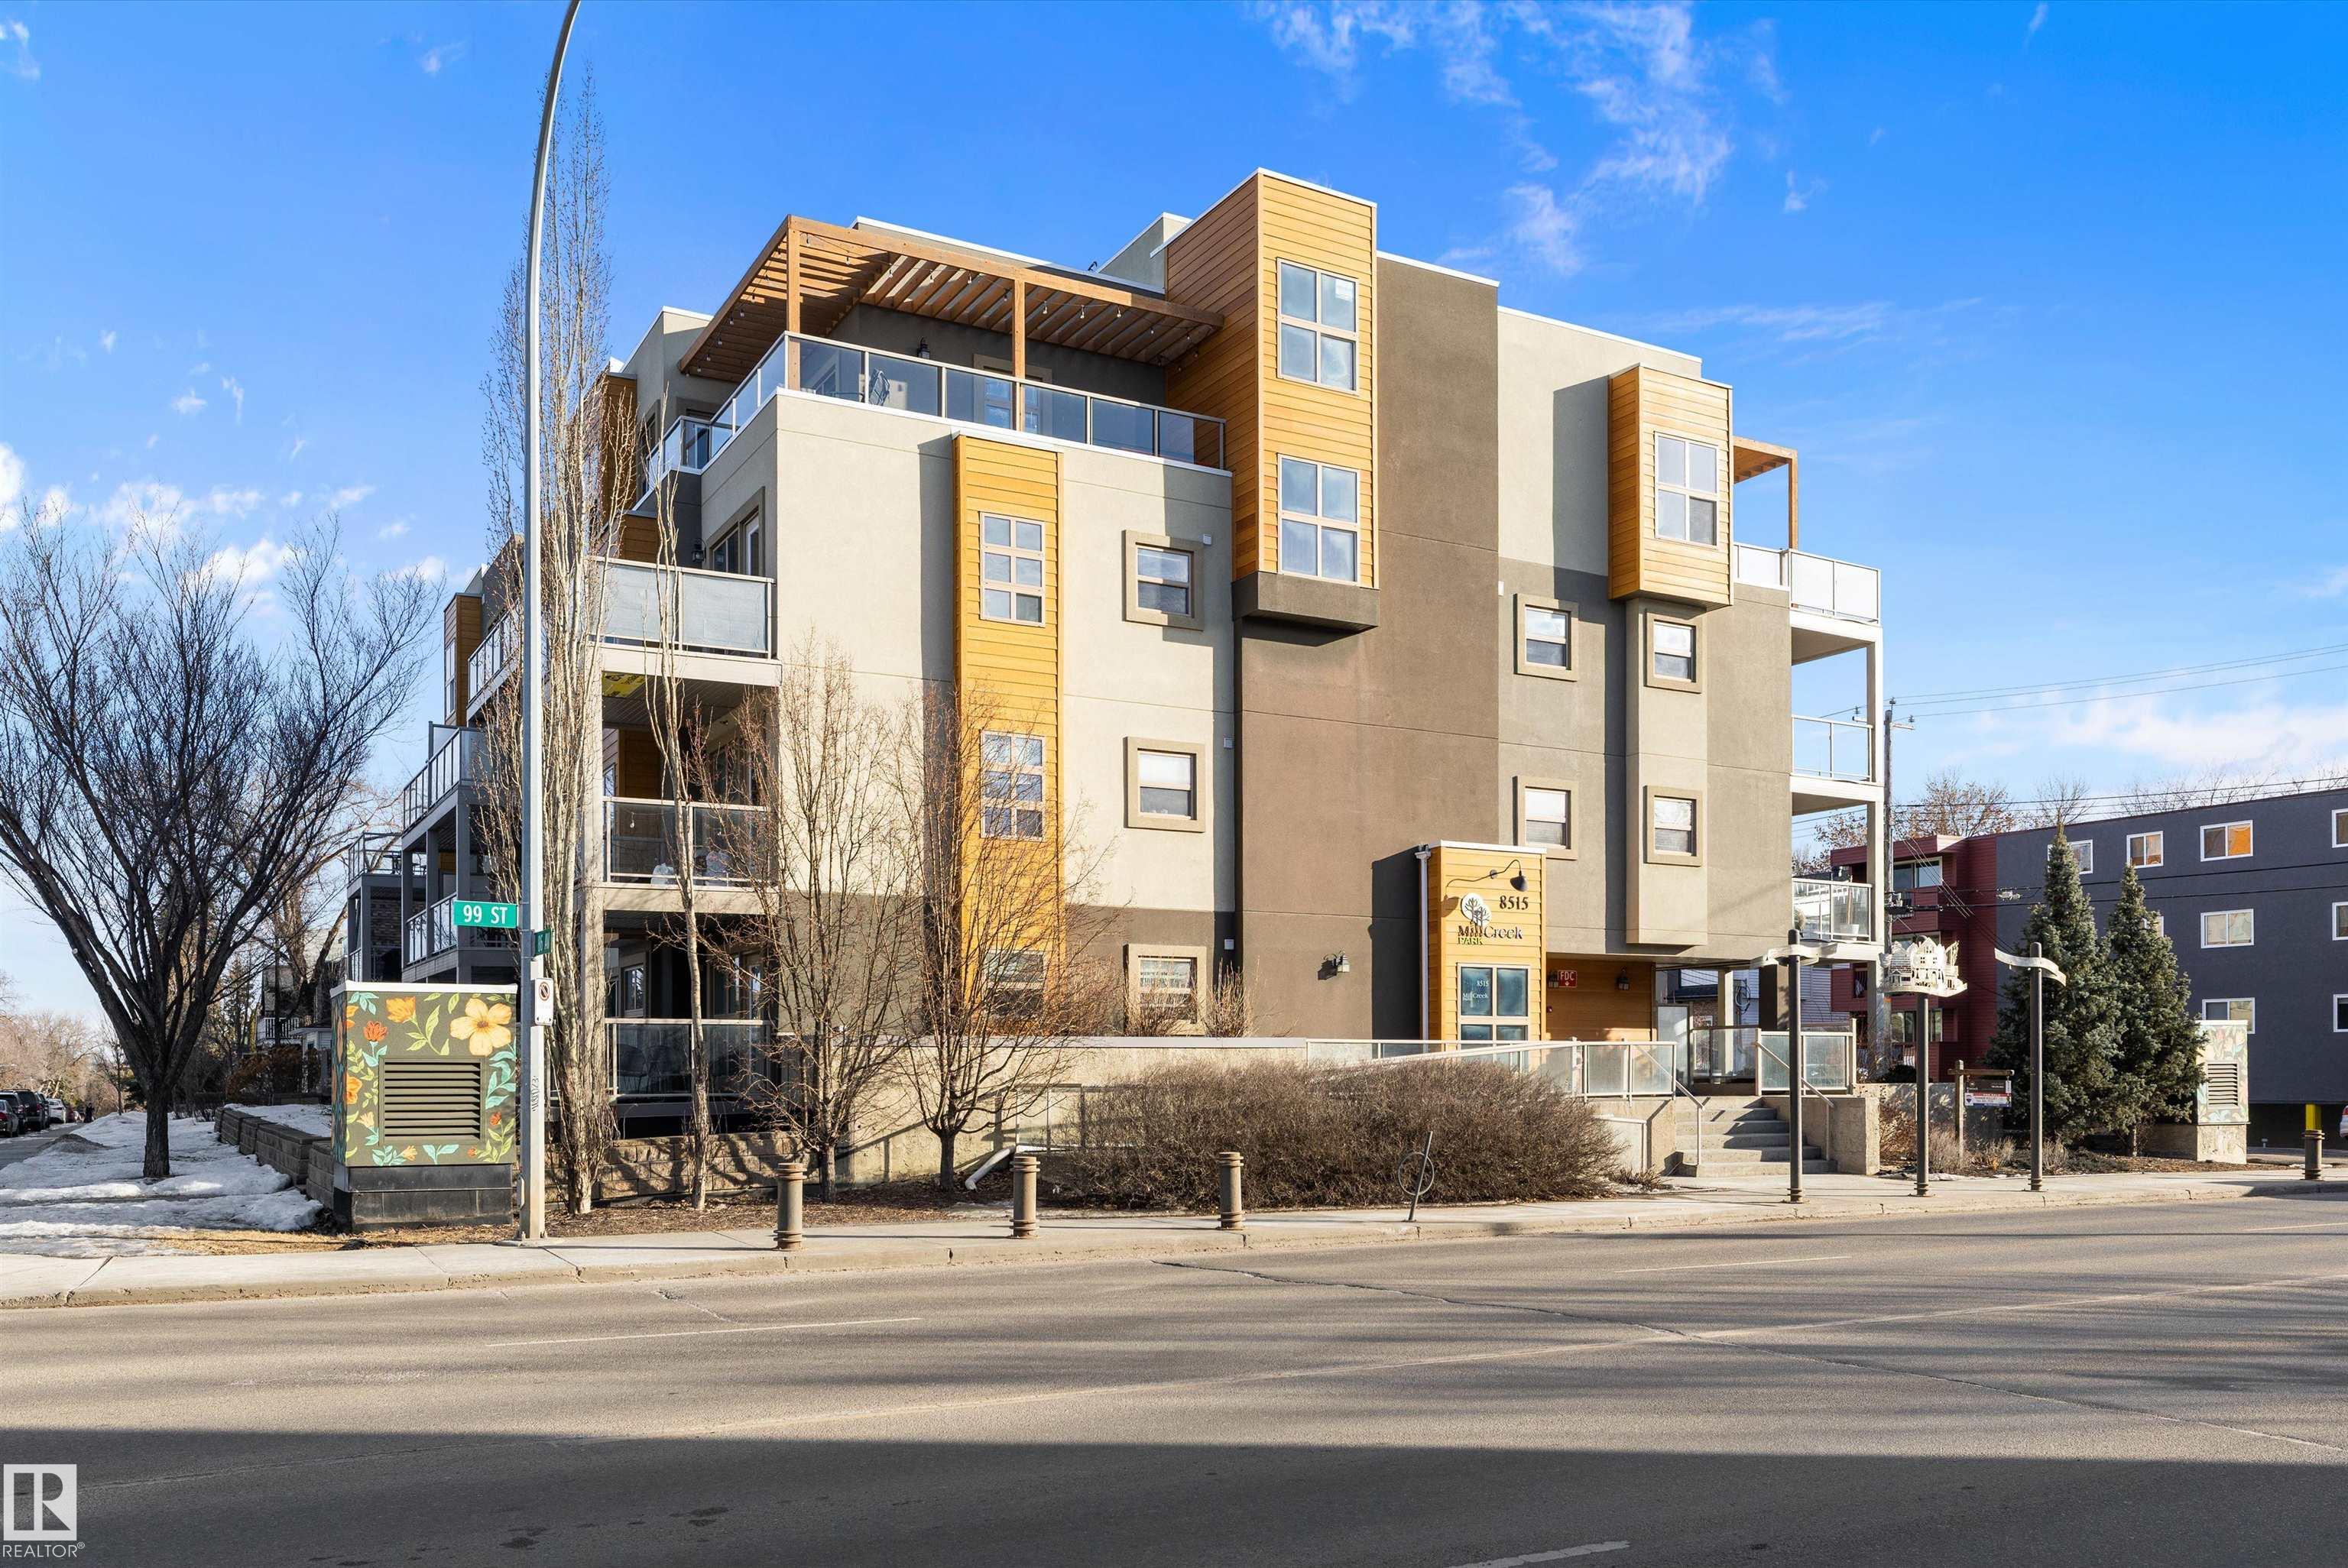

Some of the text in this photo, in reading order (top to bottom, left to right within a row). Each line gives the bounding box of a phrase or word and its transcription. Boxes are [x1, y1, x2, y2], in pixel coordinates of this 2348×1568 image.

[1500, 895, 1529, 910] 8515
[463, 905, 508, 925] 99 ST
[1560, 971, 1575, 981] FDC
